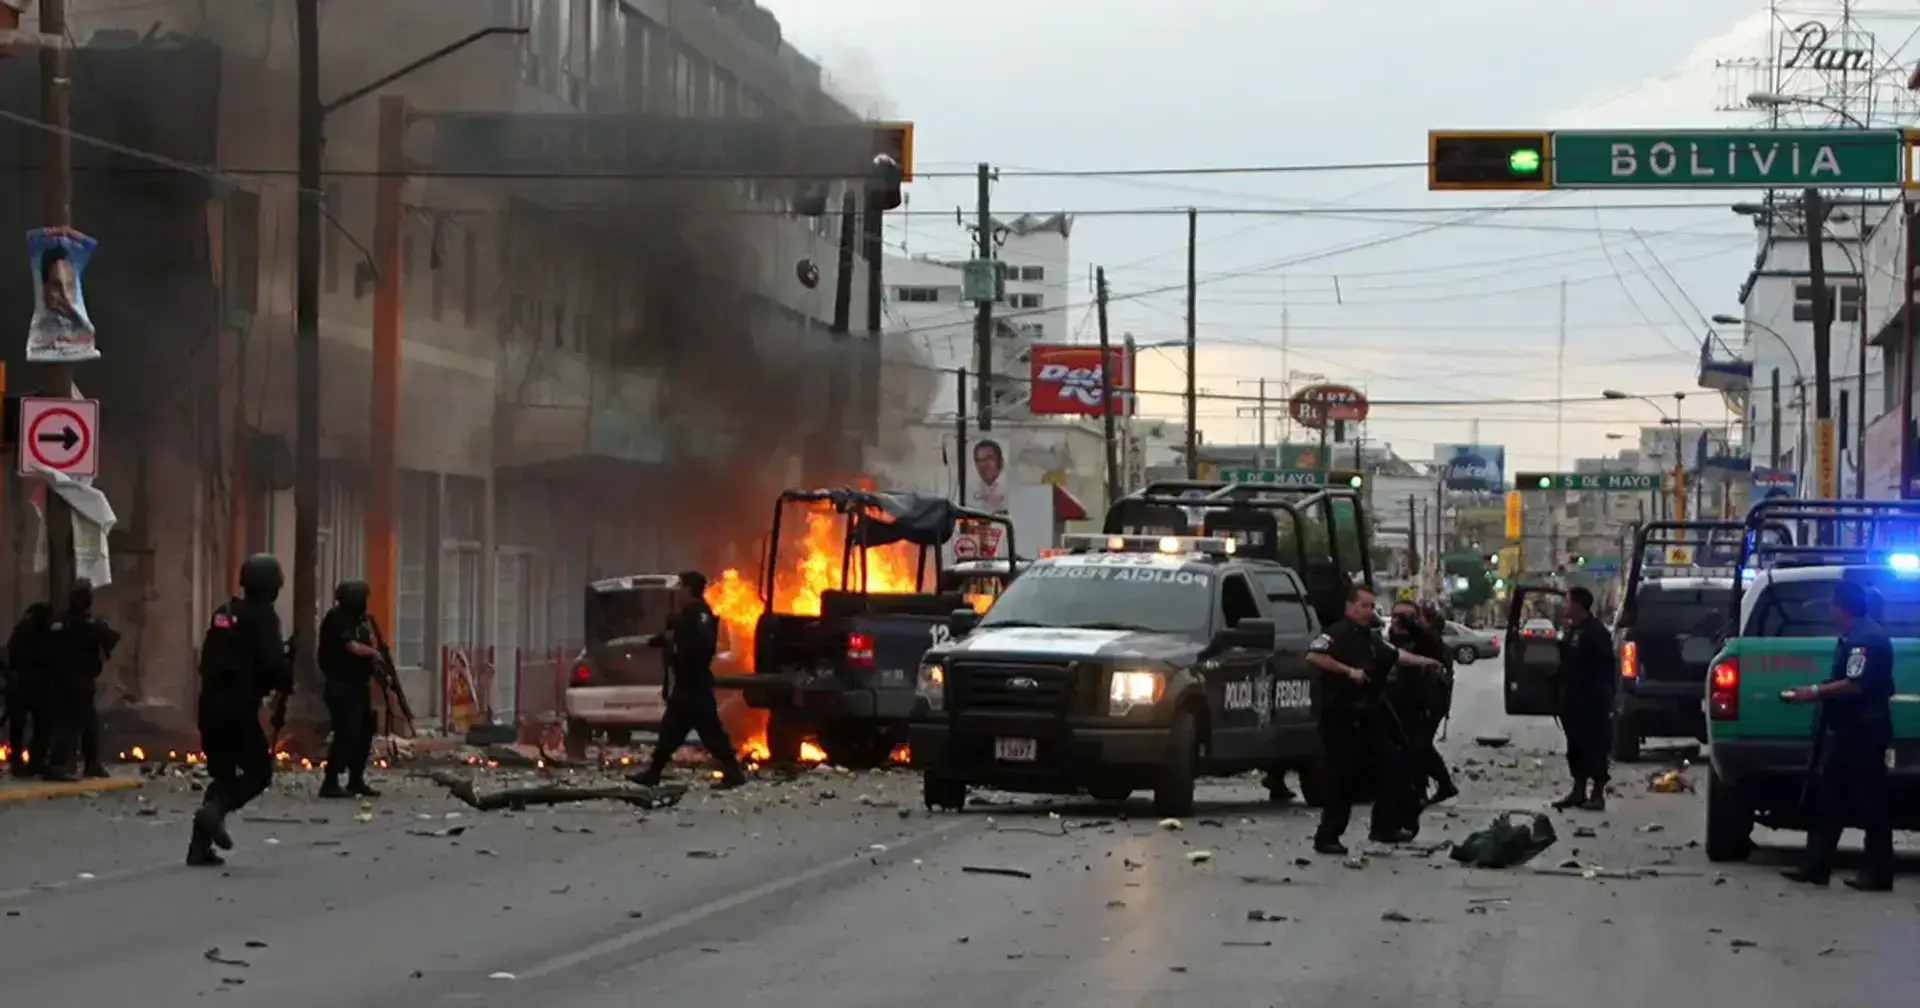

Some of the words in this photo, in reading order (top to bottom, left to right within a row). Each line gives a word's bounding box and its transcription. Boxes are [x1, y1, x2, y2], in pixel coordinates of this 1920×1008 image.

[1611, 141, 1841, 176] BOLIVIA
[1247, 472, 1264, 484] DE
[1275, 473, 1315, 485] MAYO
[1564, 475, 1574, 487] 5
[1582, 475, 1600, 487] DE
[1609, 475, 1651, 488] MAYO
